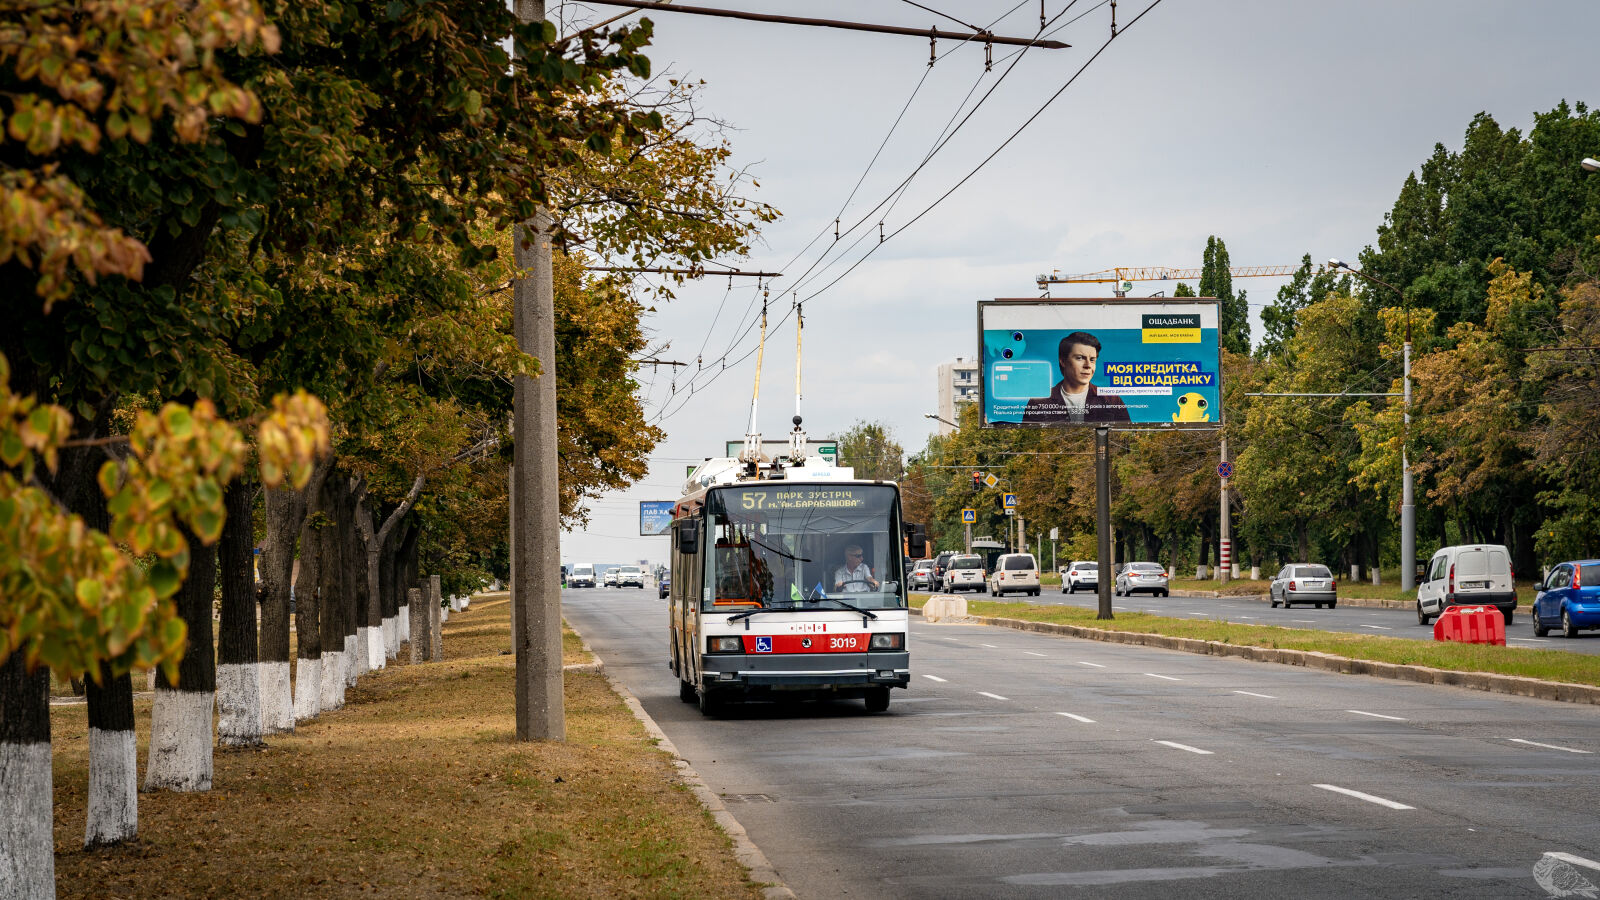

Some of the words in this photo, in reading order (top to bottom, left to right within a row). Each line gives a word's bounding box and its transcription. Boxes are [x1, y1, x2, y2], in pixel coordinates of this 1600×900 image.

[1148, 318, 1194, 326] ОЩАДБАНК
[1106, 364, 1133, 374] МОЯ
[1135, 363, 1199, 375] КРЕДИТКА
[1113, 375, 1133, 386] ВІД
[1134, 374, 1212, 386] ОЩАДБАНКУ
[742, 491, 767, 510] 57
[776, 491, 803, 500] ПАРК
[808, 491, 853, 499] ЗУСТРІЧ
[830, 637, 857, 649] 3019
